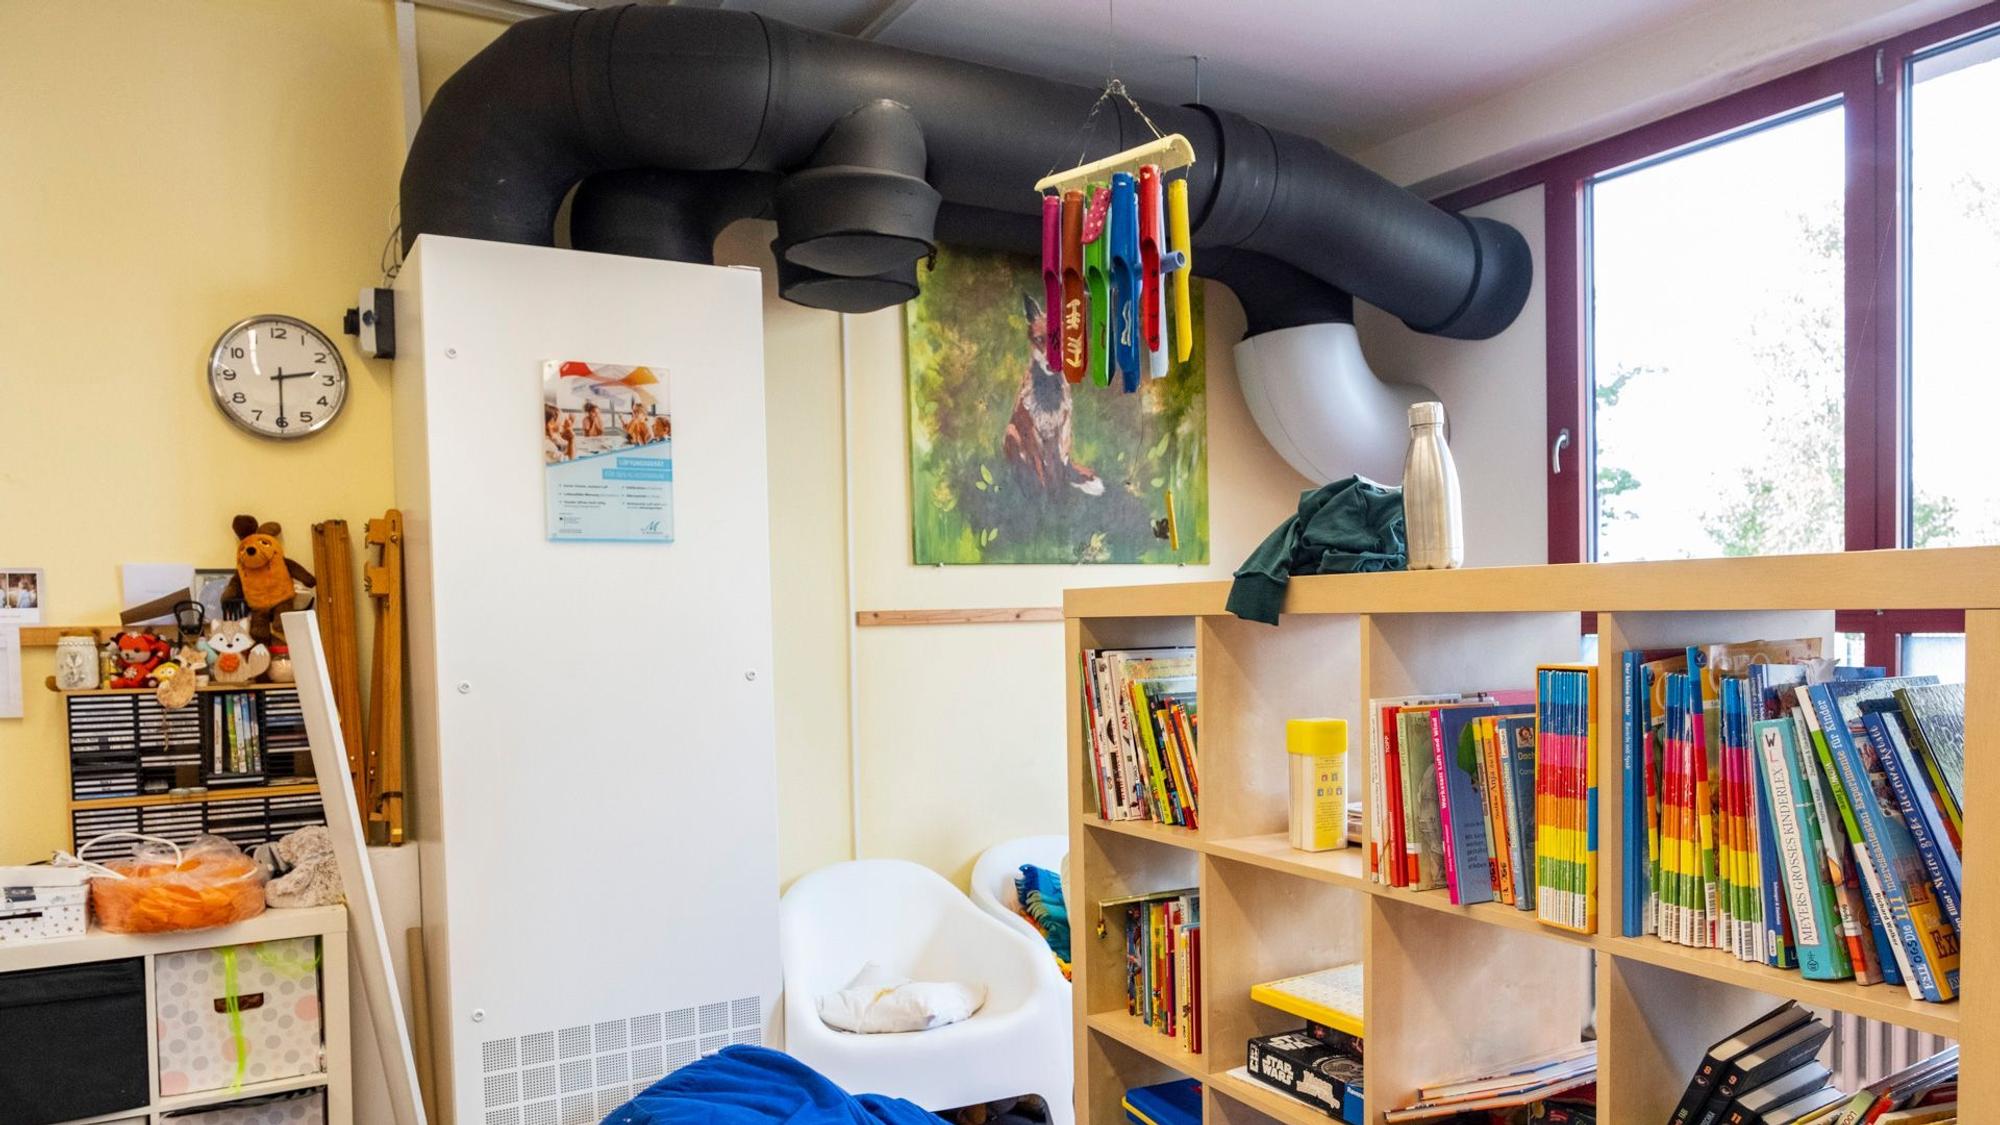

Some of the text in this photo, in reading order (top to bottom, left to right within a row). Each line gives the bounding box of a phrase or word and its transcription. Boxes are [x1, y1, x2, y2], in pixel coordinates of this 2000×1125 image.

[270, 327, 287, 339] 12
[301, 335, 305, 346] 1
[230, 347, 244, 359] 10
[314, 352, 327, 363] 2
[223, 369, 236, 380] 9
[322, 375, 335, 386] 3
[232, 392, 247, 404] 8
[316, 396, 328, 407] 4
[251, 409, 263, 422] 7
[275, 416, 289, 429] 6
[300, 411, 313, 423] 5
[1818, 700, 1837, 732] Kinder
[1431, 717, 1439, 736] Wind
[1764, 732, 1776, 748] W
[1830, 733, 1842, 749] für
[1837, 751, 1866, 810] Experimente
[1870, 724, 1945, 889] Meine große Ideenwerkstatt
[1773, 768, 1814, 941] MEYERS GROSSES KINDERLEX
[1861, 812, 1897, 892] interessantesten
[1889, 896, 1911, 920] 111
[1874, 892, 1899, 946] Richard Walker
[1902, 925, 1916, 942] Die
[1907, 940, 1922, 963] OGS
[1265, 1054, 1292, 1073] STAR
[1261, 1058, 1294, 1086] WARS
[1728, 1075, 1738, 1085] 9
[1730, 1112, 1743, 1122] 11
